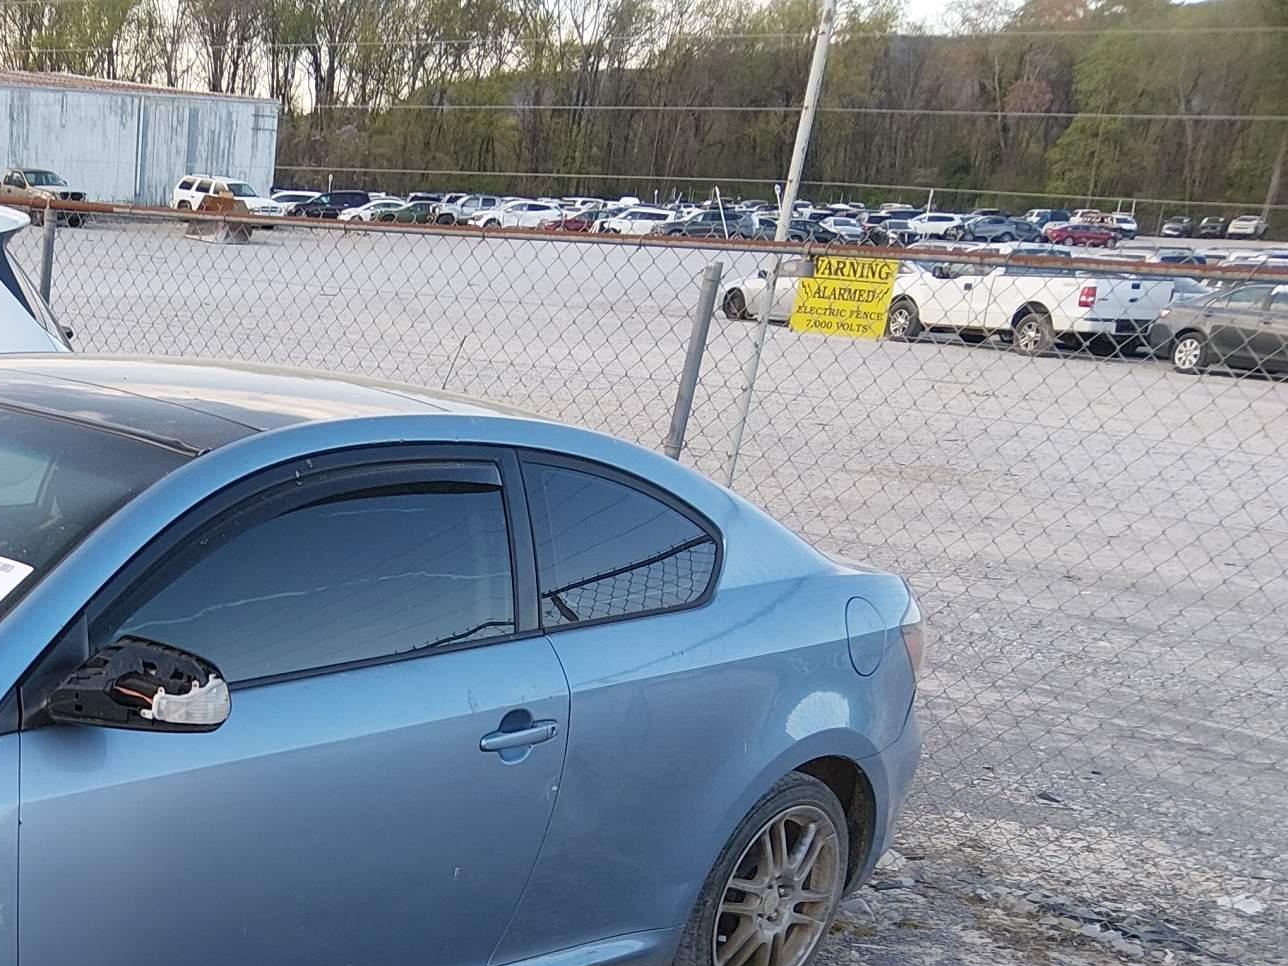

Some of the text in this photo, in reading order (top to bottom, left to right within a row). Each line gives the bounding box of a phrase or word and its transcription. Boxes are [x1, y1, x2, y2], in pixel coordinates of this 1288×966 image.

[813, 286, 876, 303] ALARMED
[796, 305, 883, 320] ELECTRIC FENCE
[836, 321, 869, 333] VOLTS
